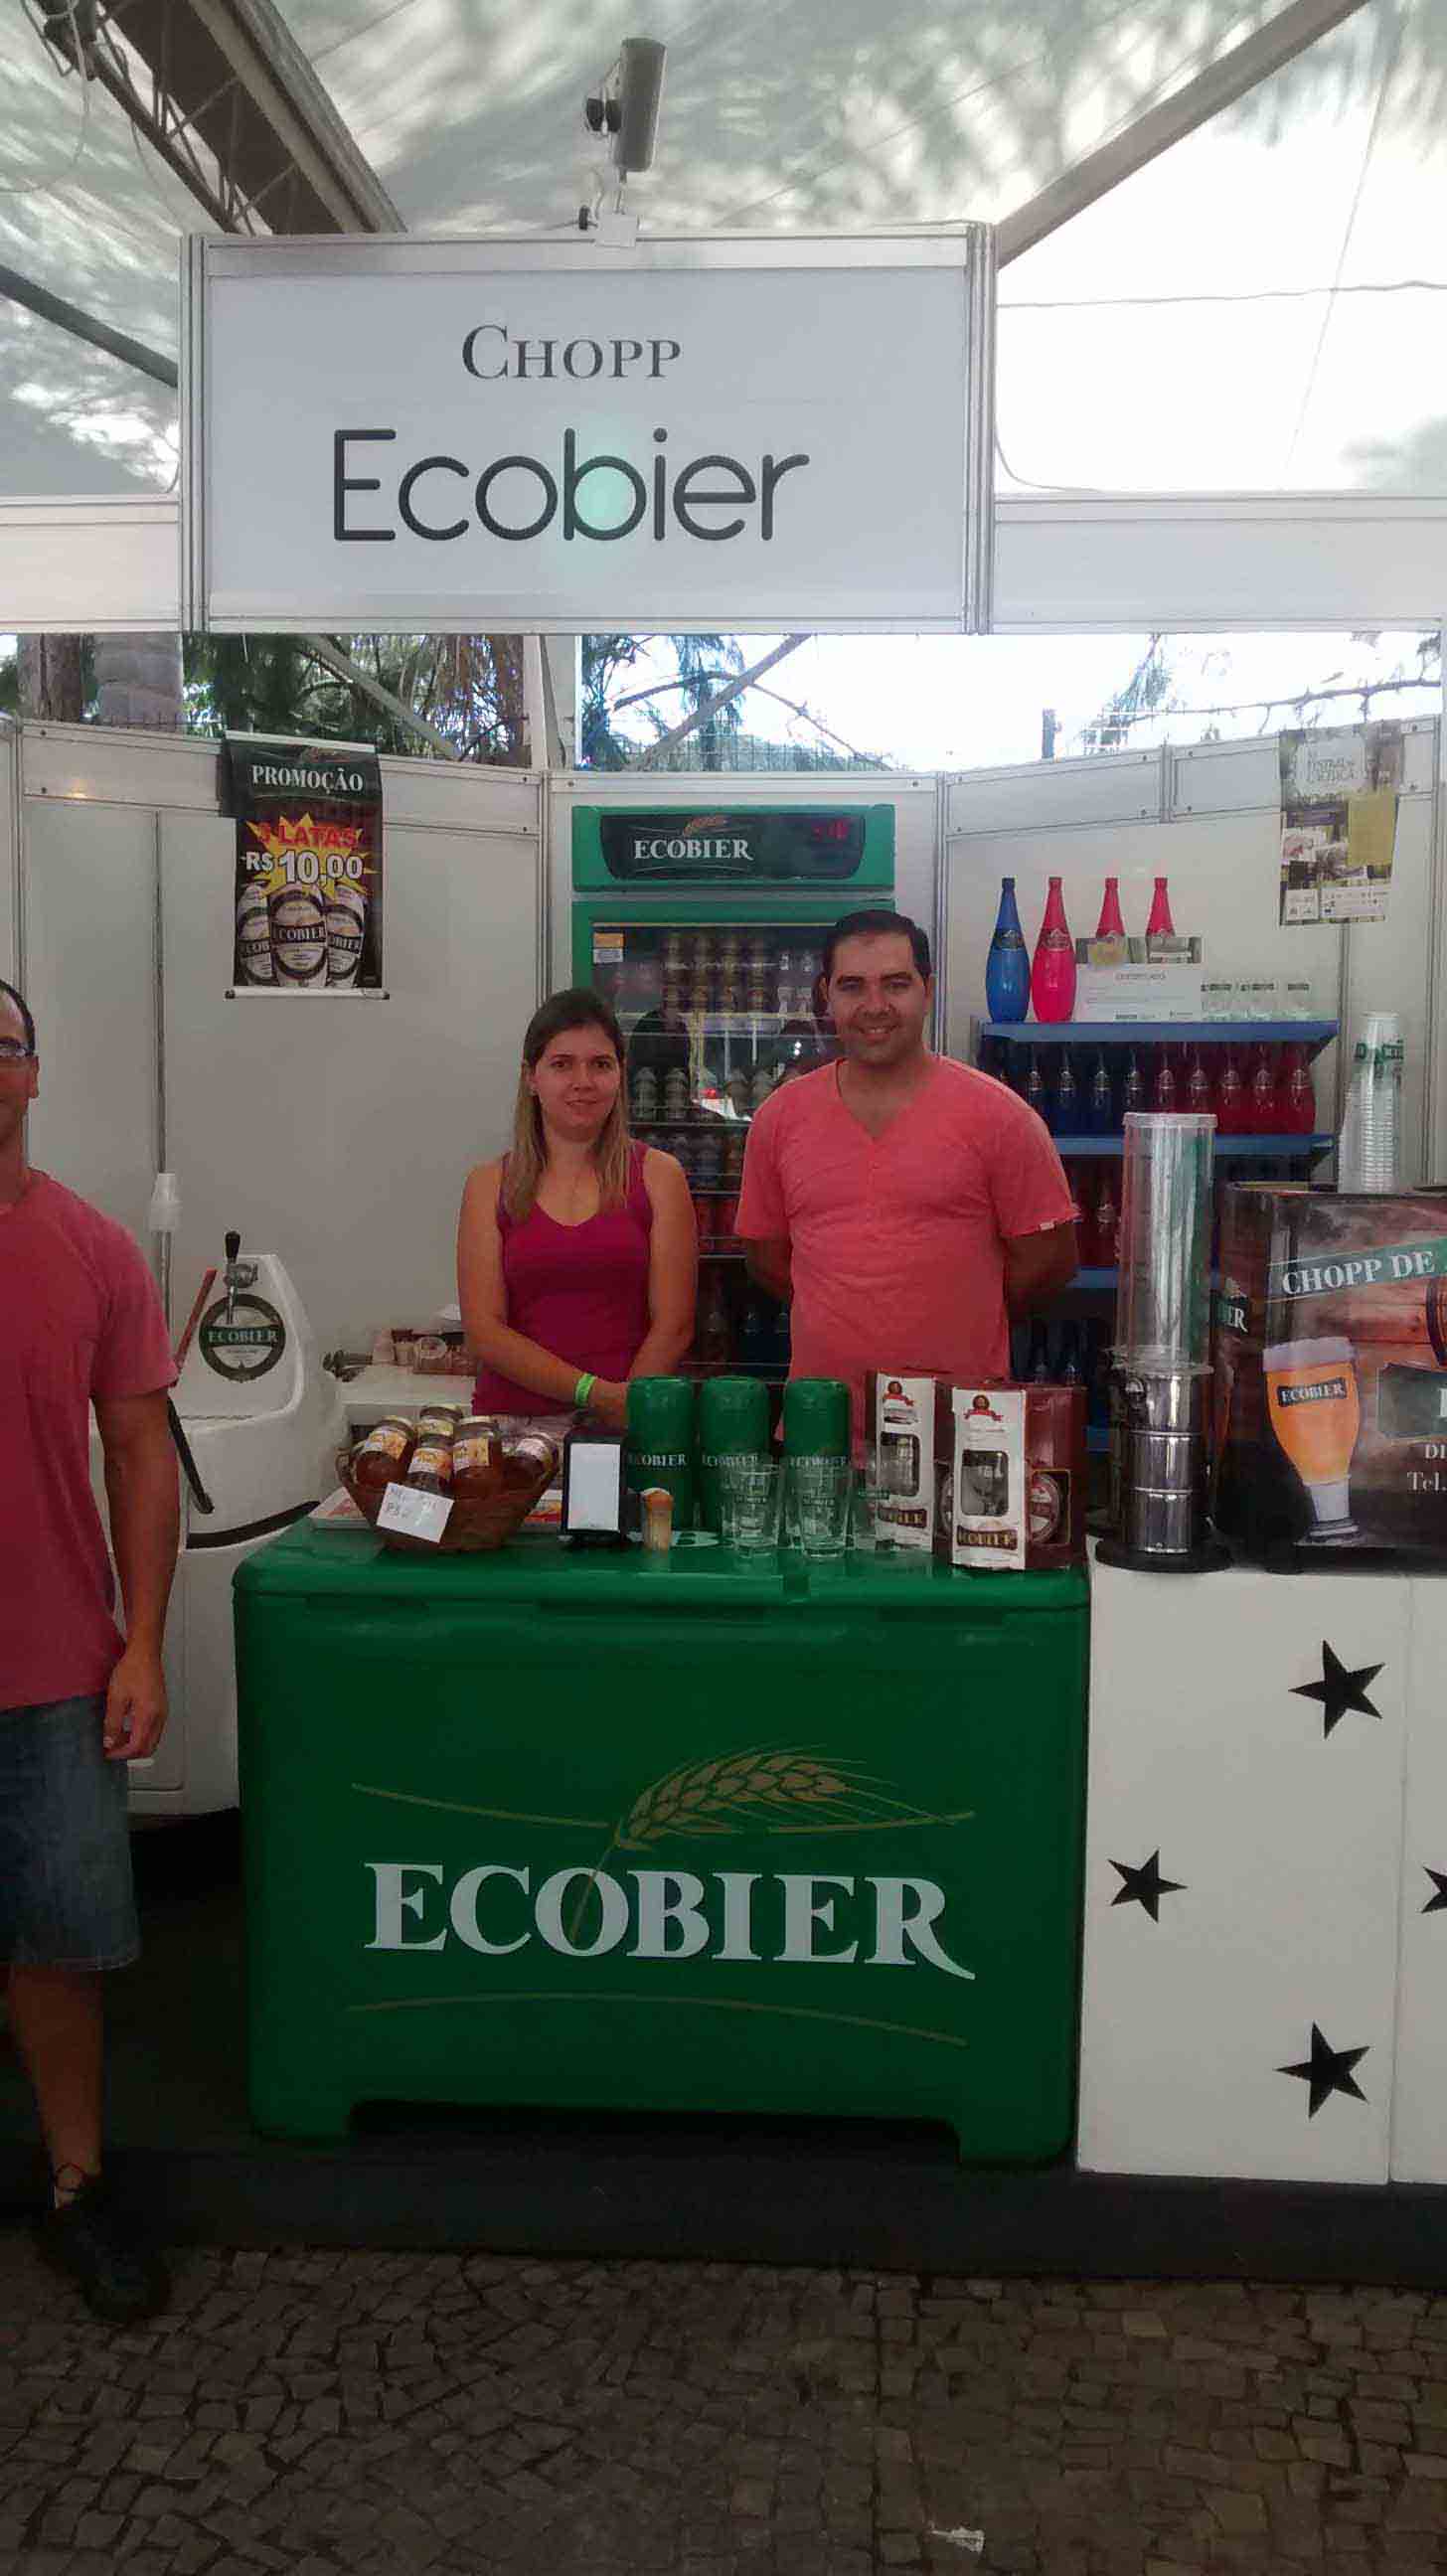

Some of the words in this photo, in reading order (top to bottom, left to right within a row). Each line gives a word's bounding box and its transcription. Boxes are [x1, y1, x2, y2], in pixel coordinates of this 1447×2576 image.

[461, 324, 682, 380] CHOPP
[334, 427, 810, 542] Ecobier
[251, 764, 364, 794] PROMOÇÃO
[278, 826, 358, 851] LATAS
[633, 839, 754, 861] ECOBIER
[1283, 1258, 1381, 1295] CHOPP
[1391, 1250, 1434, 1278] DE
[208, 1330, 278, 1343] ECOBIER
[1281, 1381, 1345, 1402] ECOBIER
[632, 1453, 687, 1468] OBIER
[1407, 1472, 1447, 1492] Tel.
[364, 1862, 976, 1980] ECOBIER
